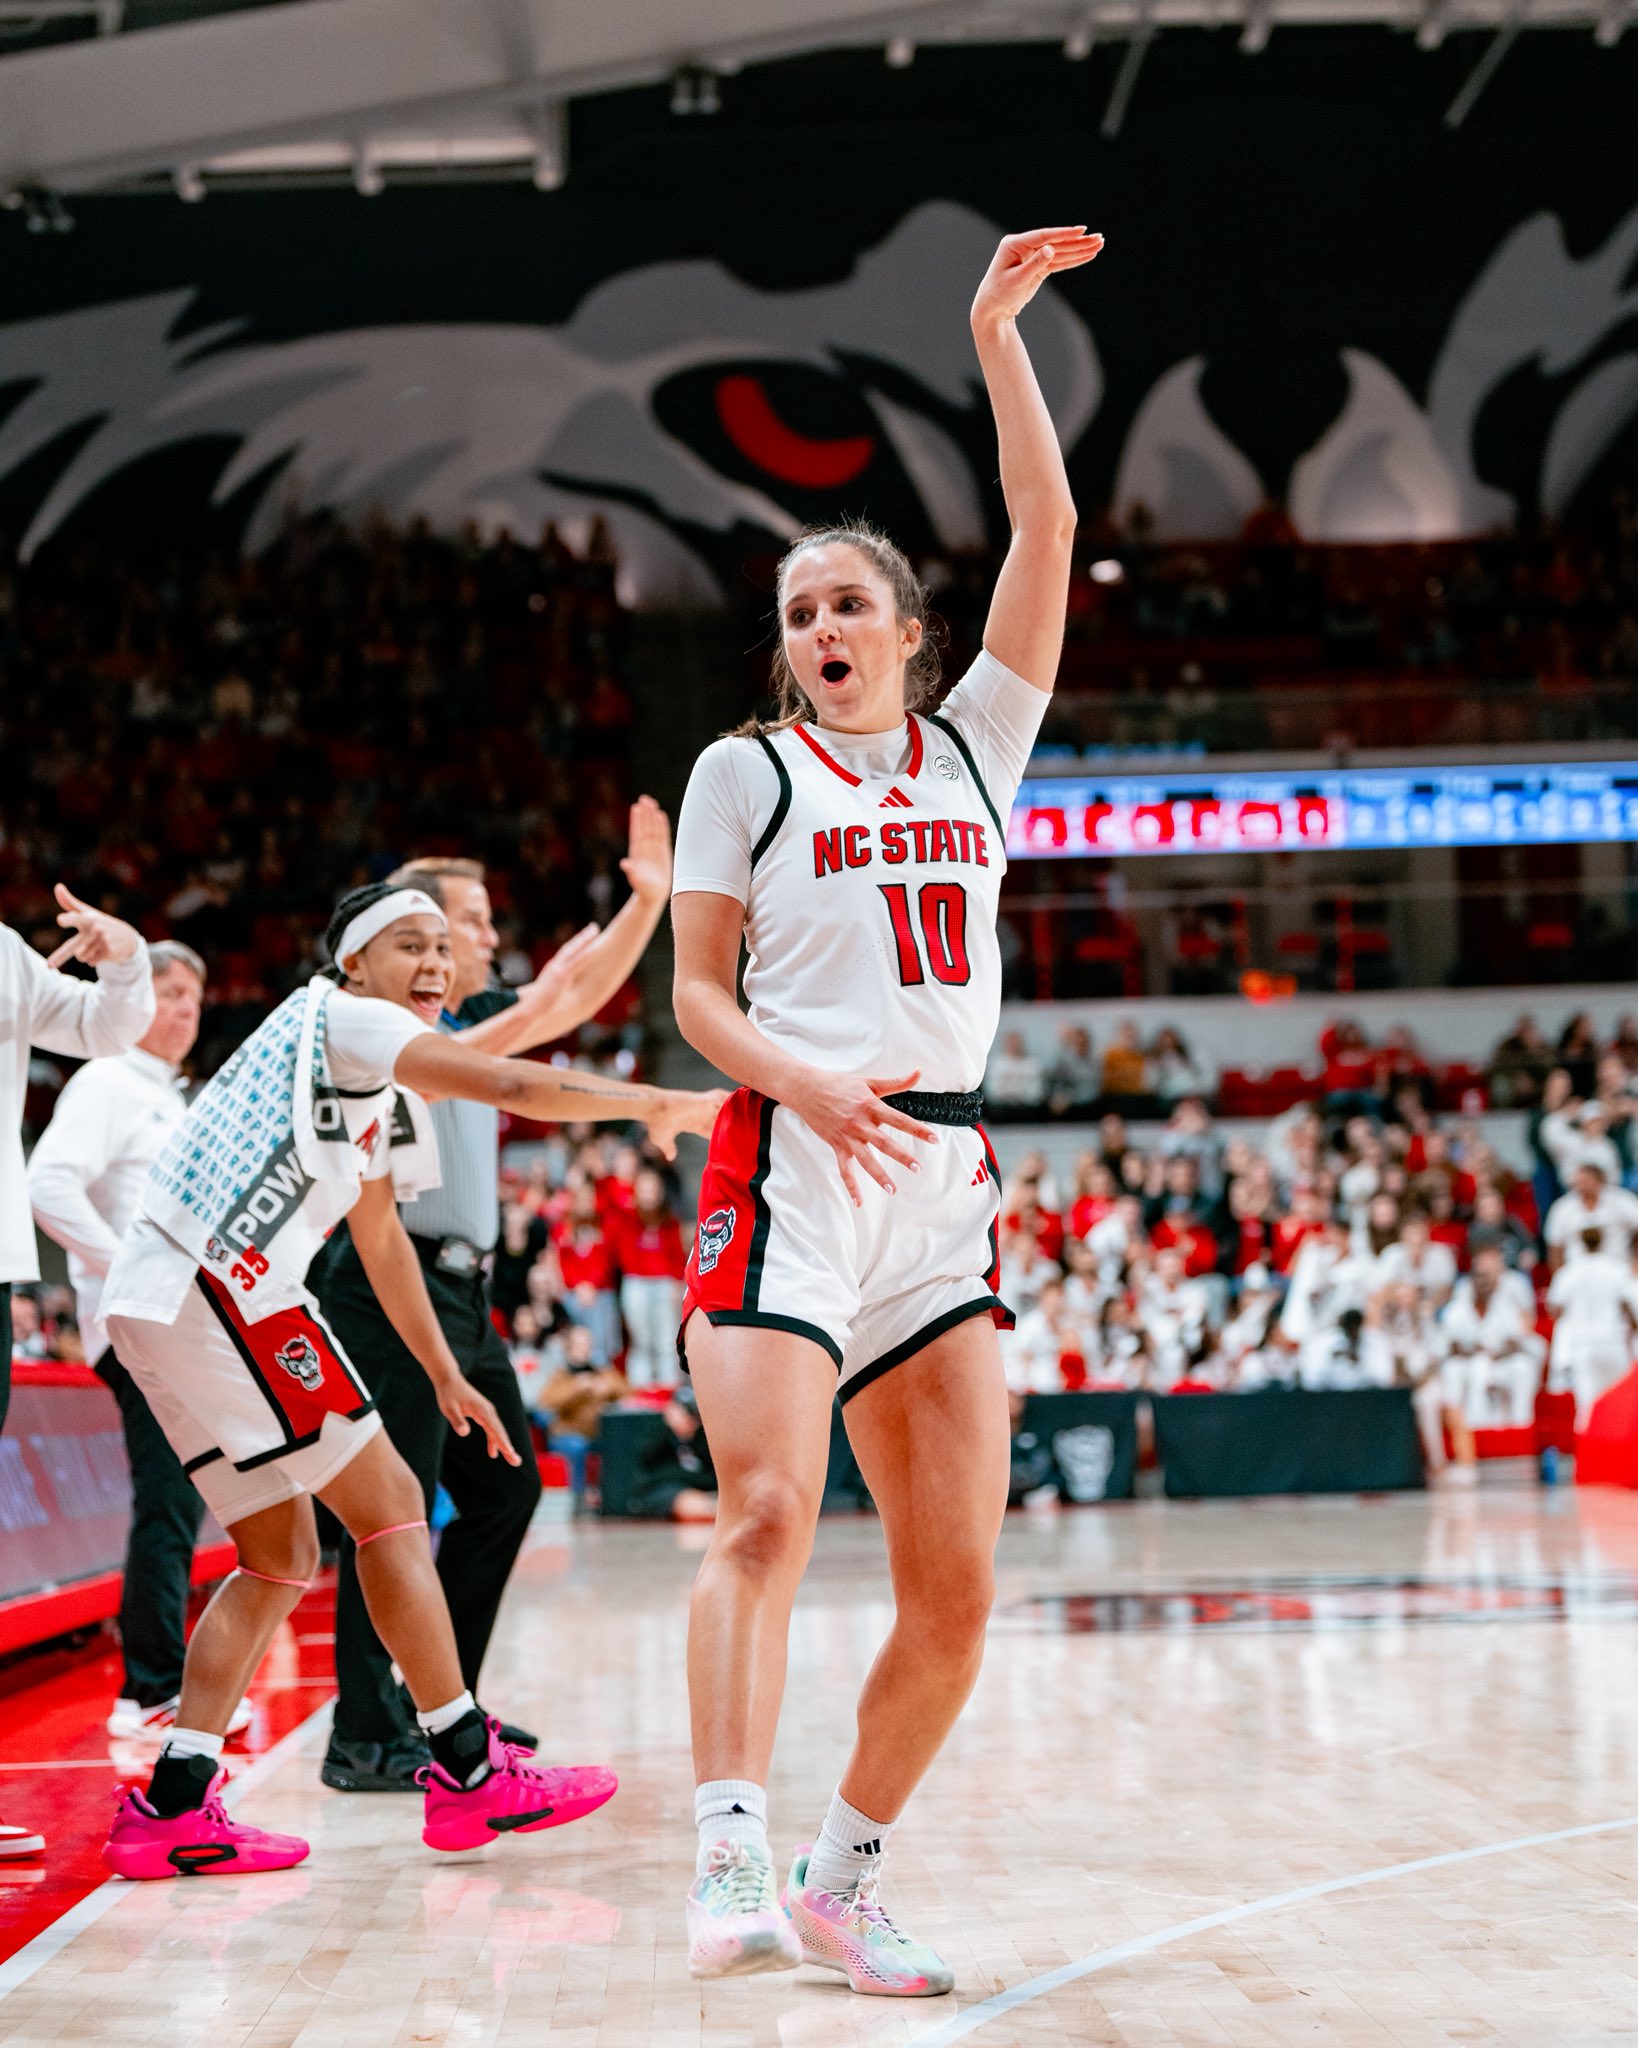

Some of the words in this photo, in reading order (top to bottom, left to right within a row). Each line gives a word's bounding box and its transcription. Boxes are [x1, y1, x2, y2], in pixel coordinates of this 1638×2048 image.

[813, 824, 873, 879] NC
[881, 819, 990, 869] STATE
[876, 882, 972, 988] 10
[230, 1244, 270, 1292] 35
